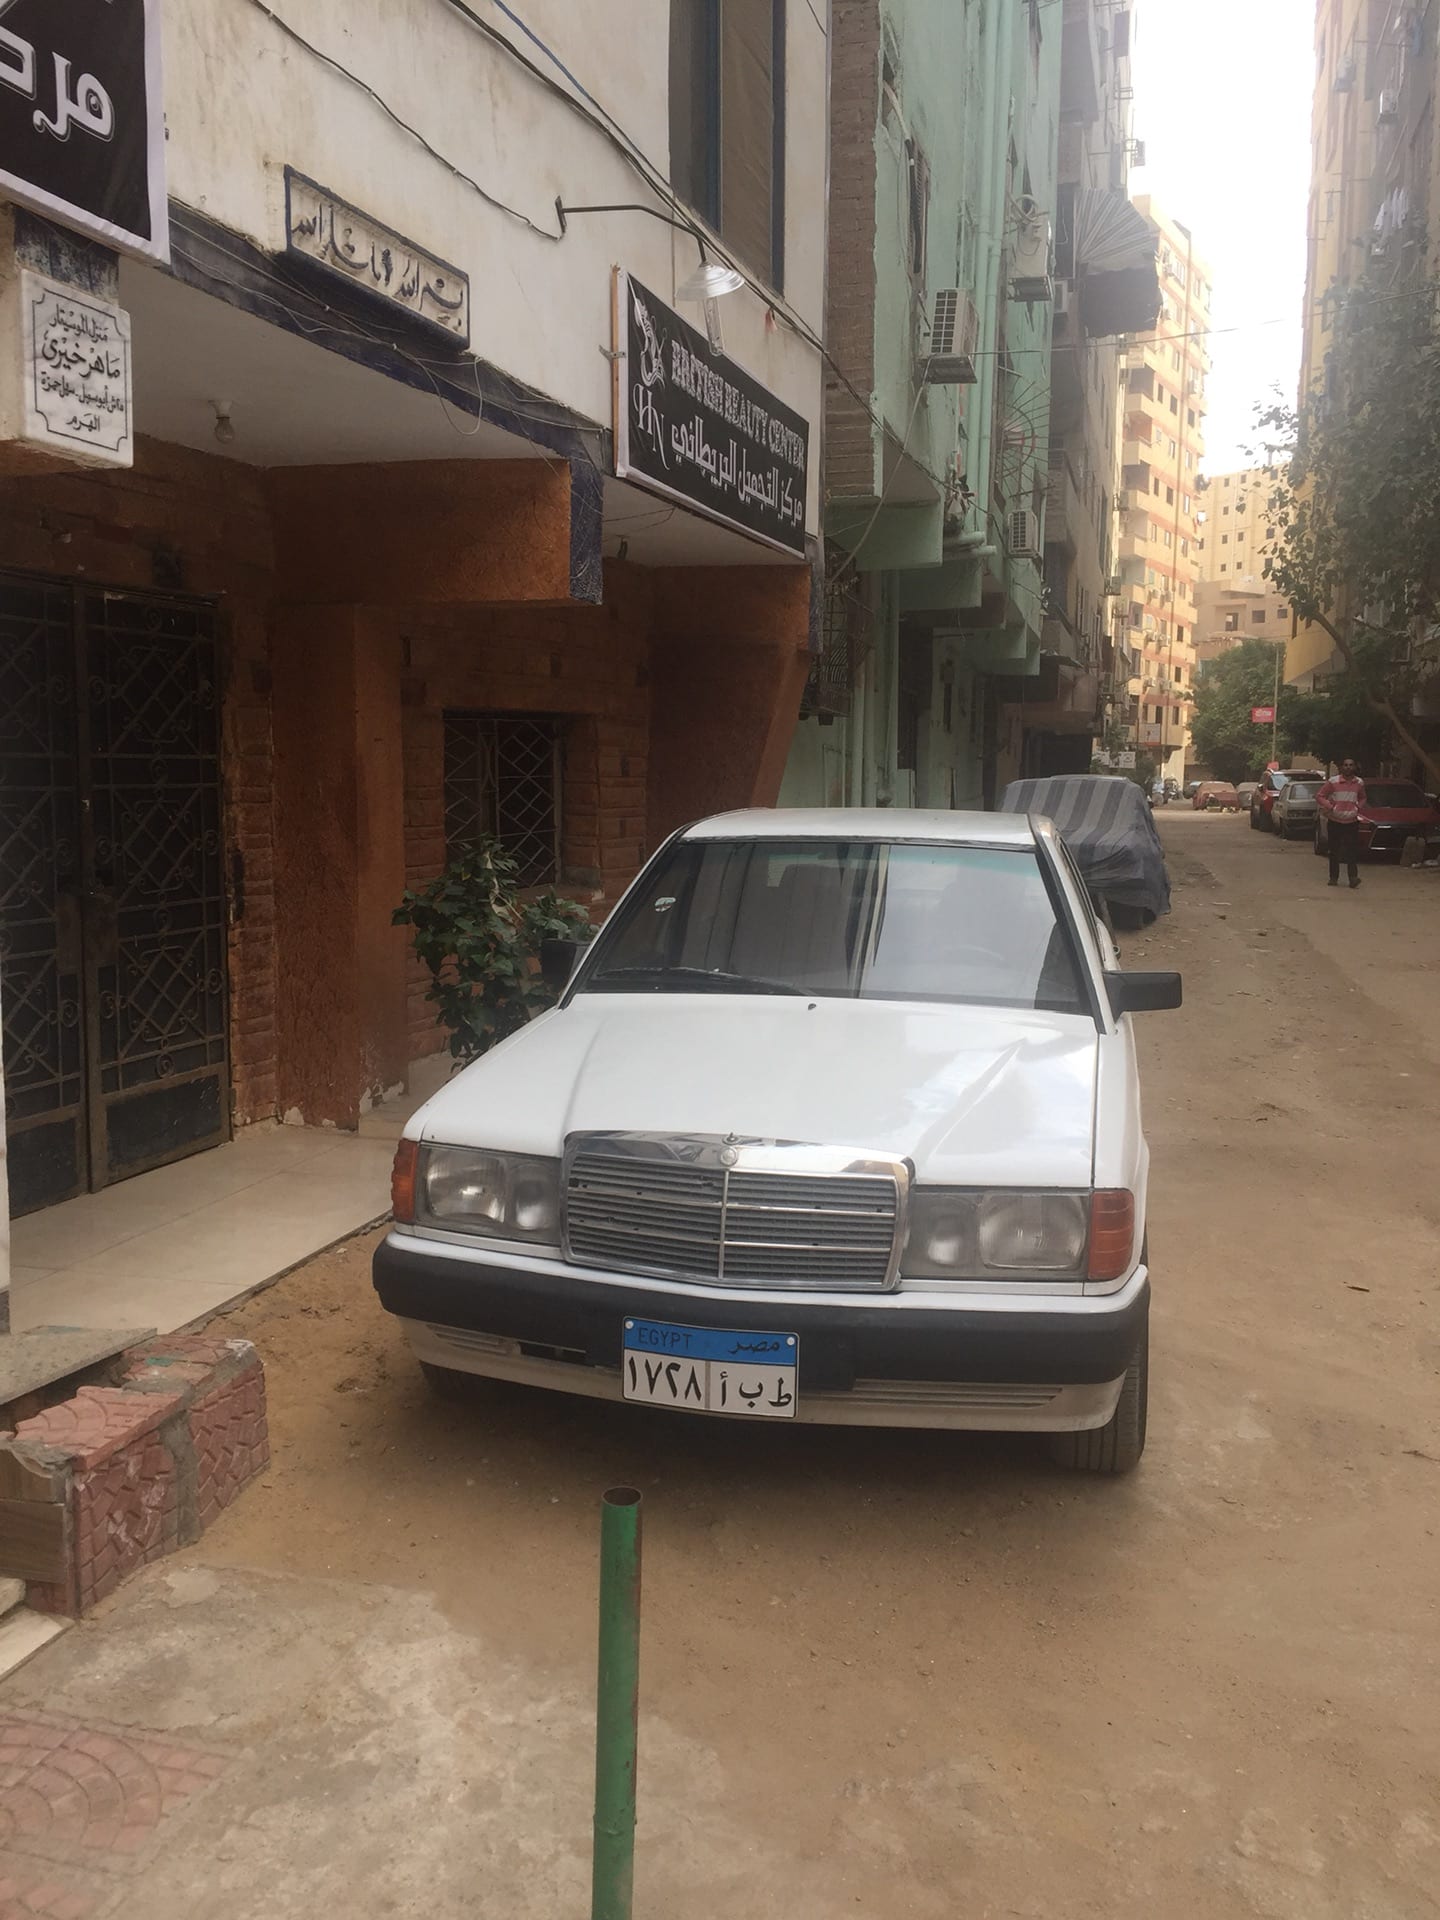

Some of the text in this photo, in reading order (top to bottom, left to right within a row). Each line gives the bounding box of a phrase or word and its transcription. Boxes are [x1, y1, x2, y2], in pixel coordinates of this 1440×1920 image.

[291, 202, 323, 243] الله
[393, 255, 420, 300] الله
[418, 279, 463, 332] بسم
[78, 347, 120, 378] ماهر
[65, 413, 100, 432] الهرم
[724, 381, 768, 446] BEAUTY
[768, 418, 804, 472] CENTER
[738, 448, 778, 511] التجميل
[778, 478, 802, 527] مركز
[638, 1327, 693, 1348] EGYPT
[728, 1339, 780, 1355] مصر
[628, 1356, 702, 1401] ١٧٢٨
